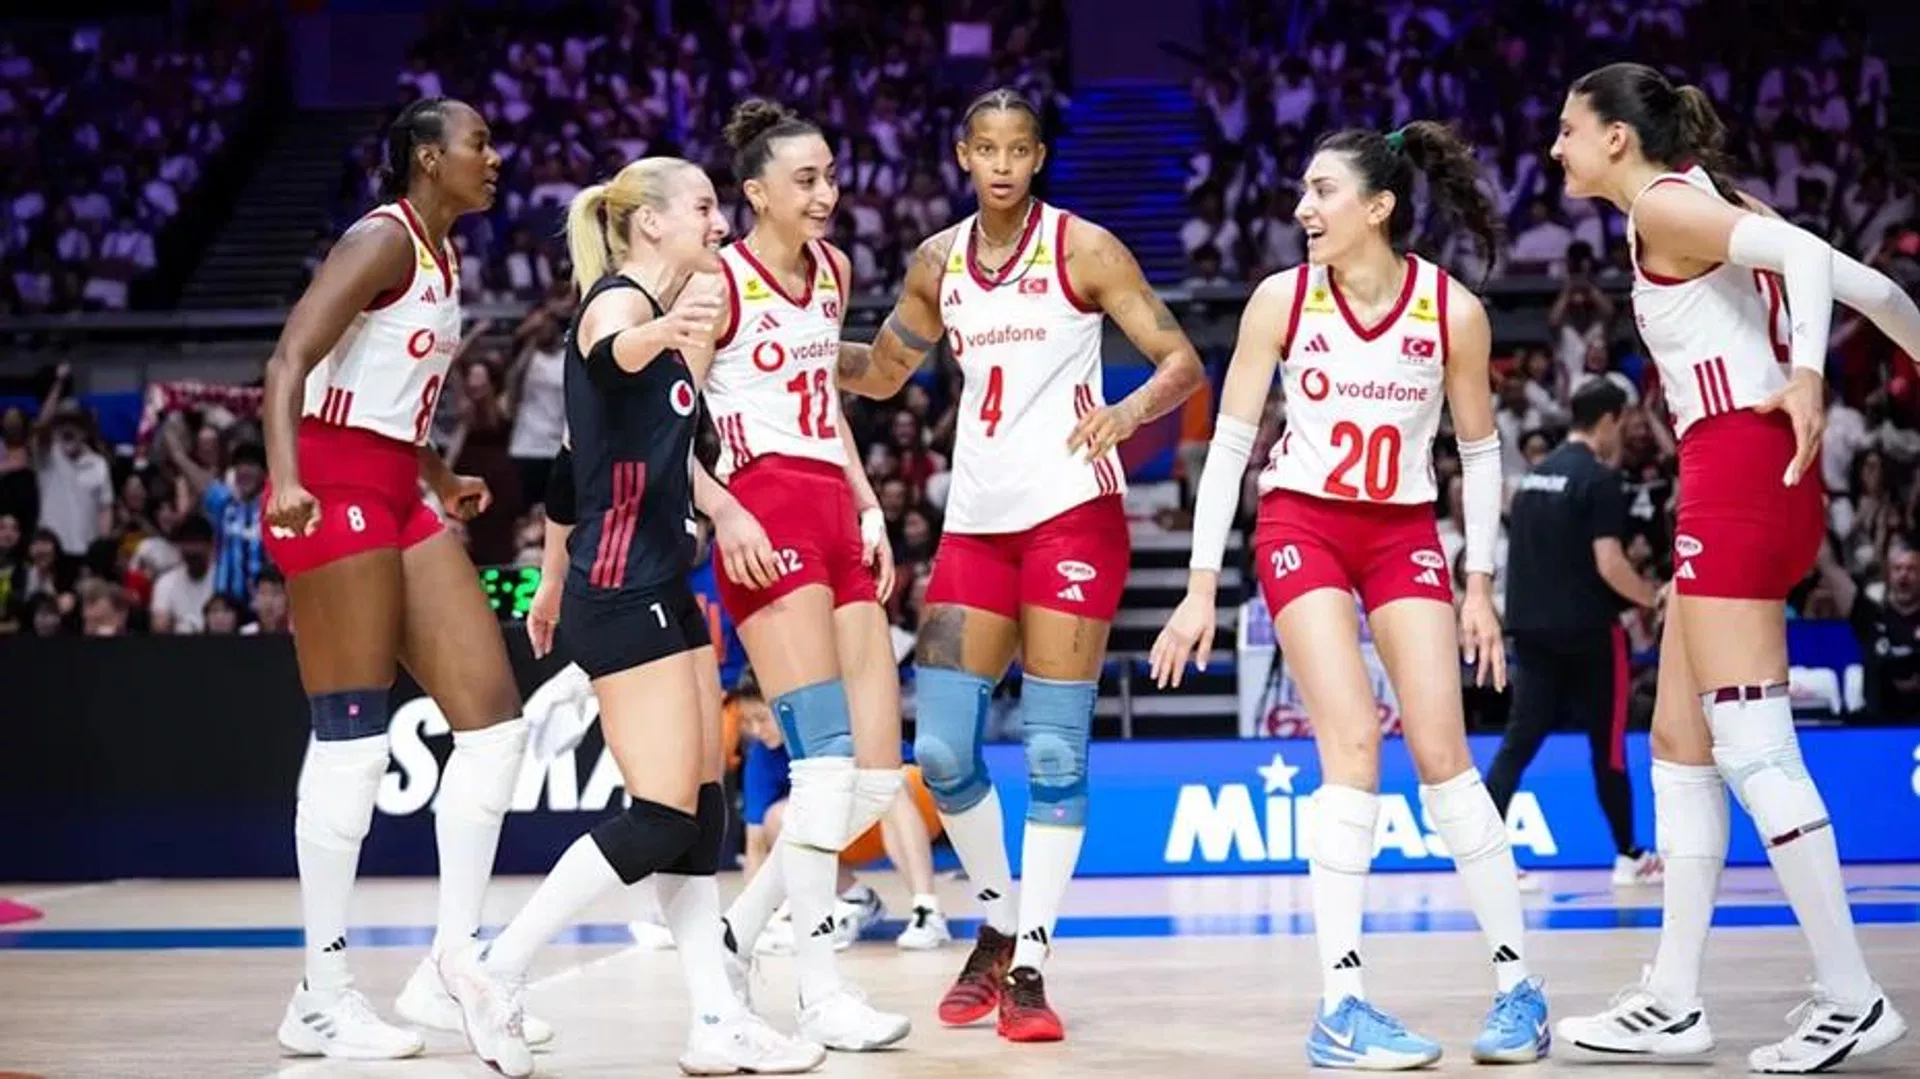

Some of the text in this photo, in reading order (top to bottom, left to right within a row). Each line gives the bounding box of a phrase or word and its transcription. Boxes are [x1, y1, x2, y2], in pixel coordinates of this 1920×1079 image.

[966, 324, 1047, 347] vodafone
[786, 368, 837, 439] 12
[979, 365, 1004, 437] 4
[1336, 381, 1429, 401] vodafone
[414, 374, 439, 443] 8
[1323, 421, 1402, 501] 20
[347, 505, 366, 532] 8
[772, 549, 804, 576] 12
[1271, 544, 1302, 579] 20
[650, 603, 668, 629] 1
